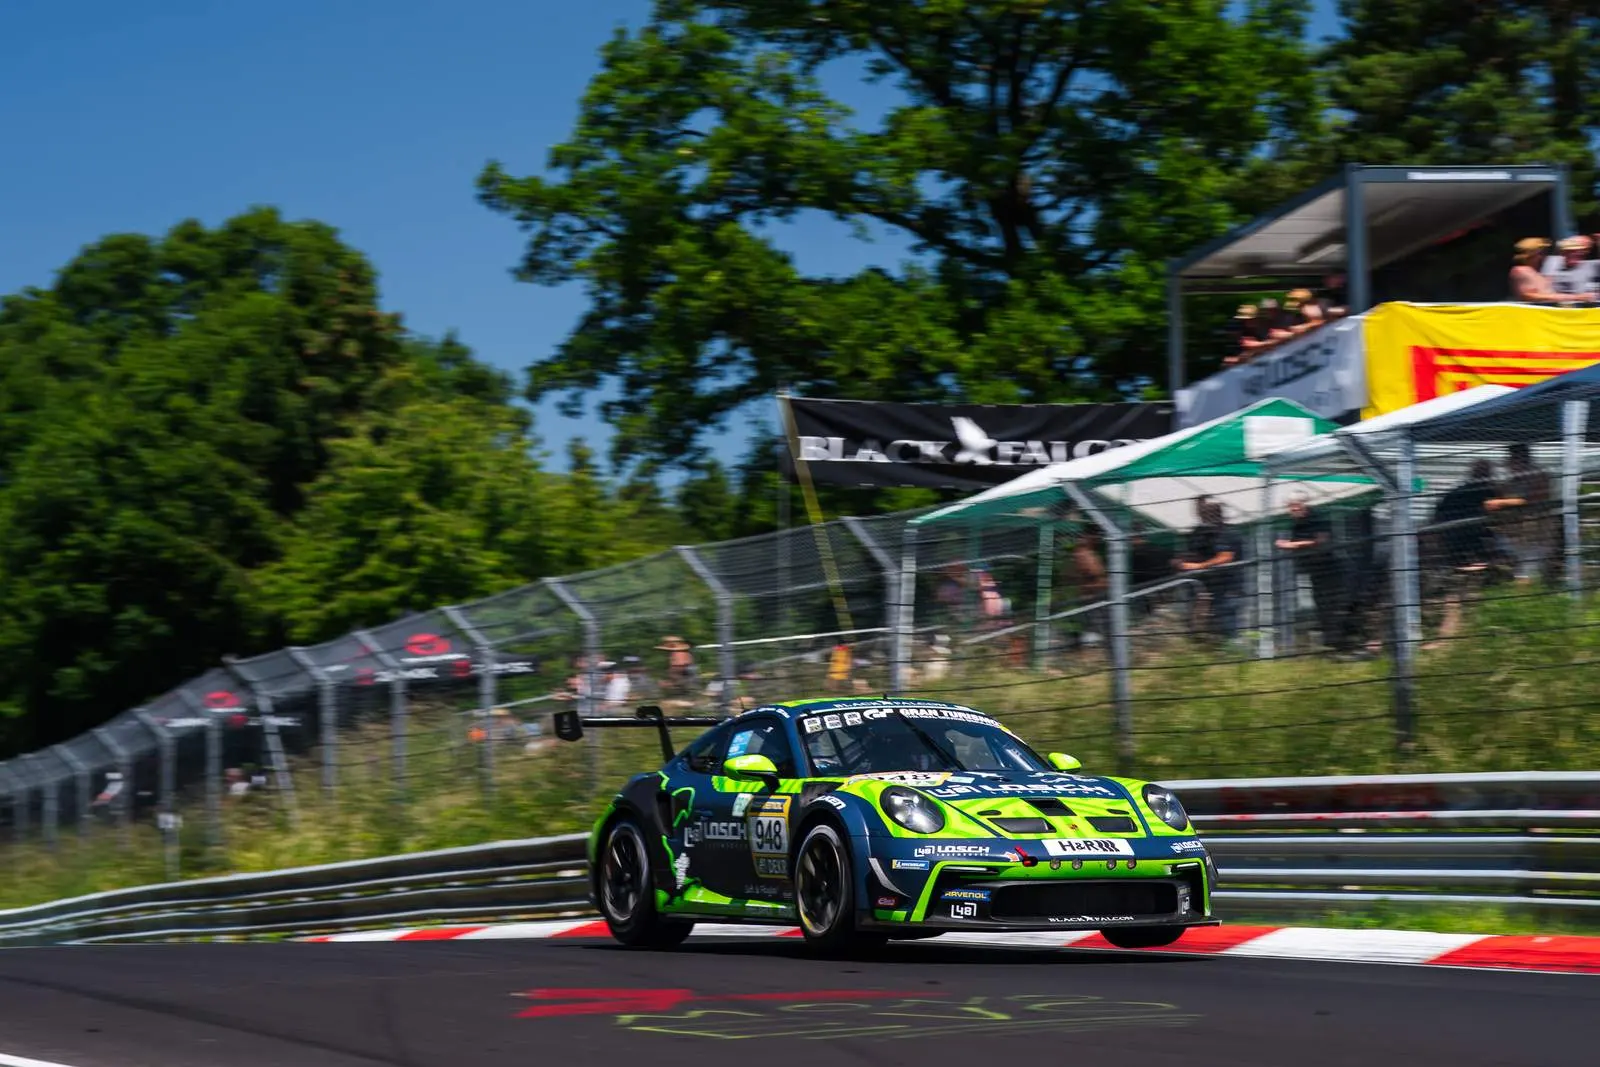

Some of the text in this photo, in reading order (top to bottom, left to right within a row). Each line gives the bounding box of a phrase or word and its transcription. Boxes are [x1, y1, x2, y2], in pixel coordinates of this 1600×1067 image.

[799, 434, 951, 465] BLACK
[899, 708, 938, 718] GRAN
[940, 709, 1001, 728] TURISMO
[979, 784, 1111, 793] LOSCH
[704, 822, 747, 840] LOSCH
[756, 820, 782, 850] 948
[937, 845, 990, 853] LOSCH
[1058, 840, 1099, 852] H&R
